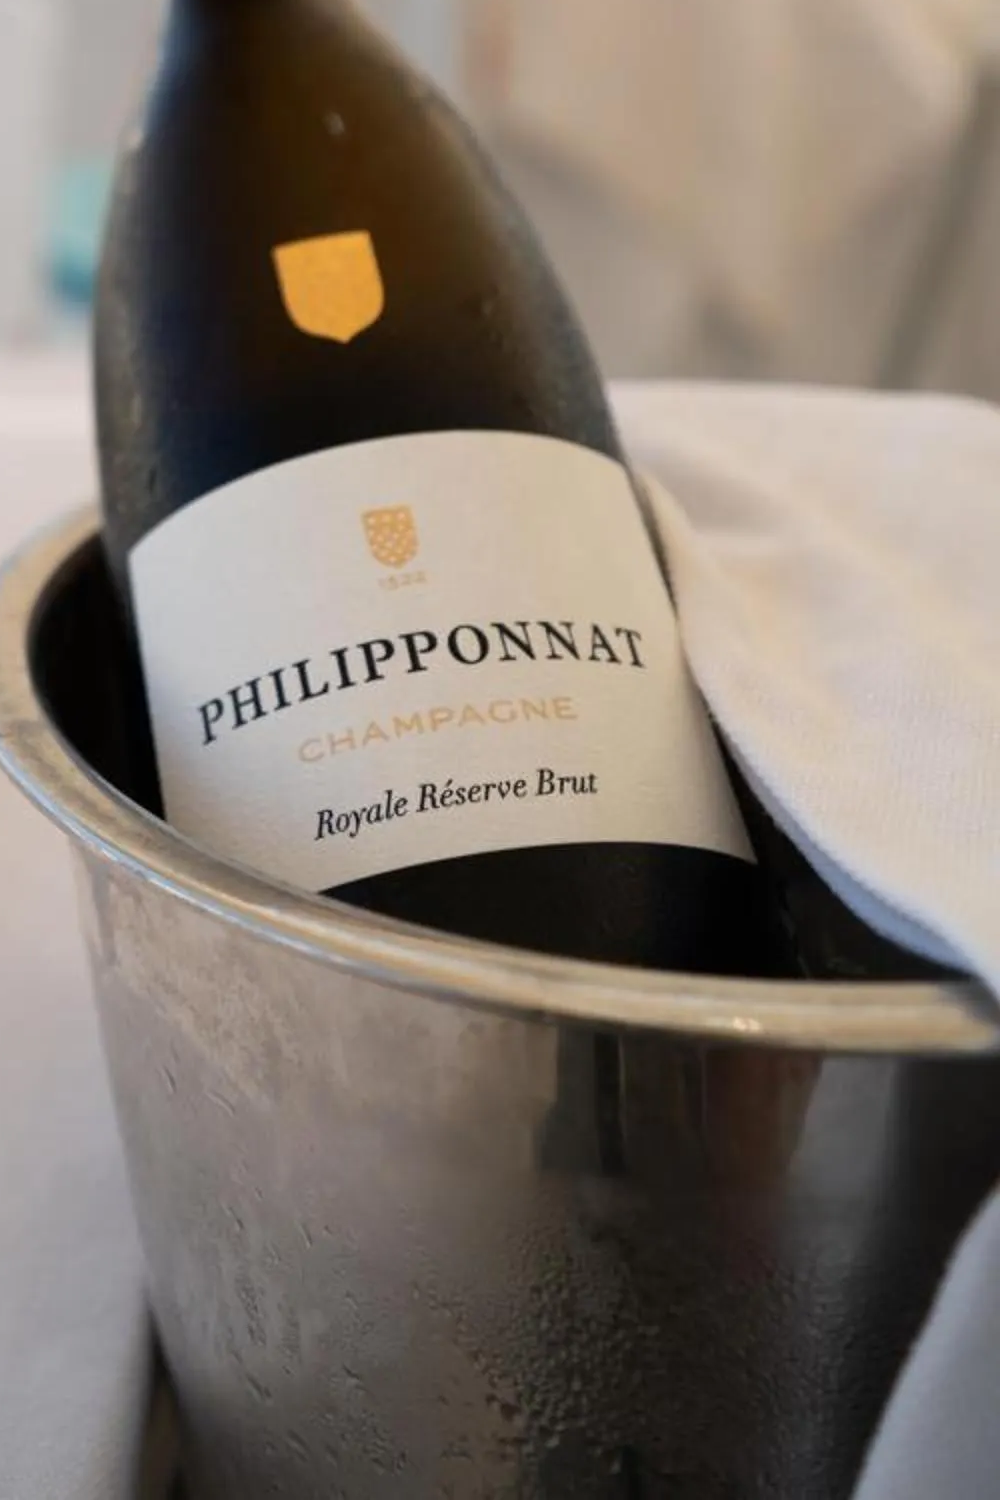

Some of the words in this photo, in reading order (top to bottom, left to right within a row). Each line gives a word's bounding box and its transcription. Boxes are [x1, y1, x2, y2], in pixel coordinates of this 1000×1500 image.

[197, 620, 647, 746] PHILIPPONNAT
[299, 696, 579, 764] CHAMPAGNE
[314, 789, 408, 840] Royale
[415, 778, 528, 813] Réserve
[534, 768, 599, 797] Brut
